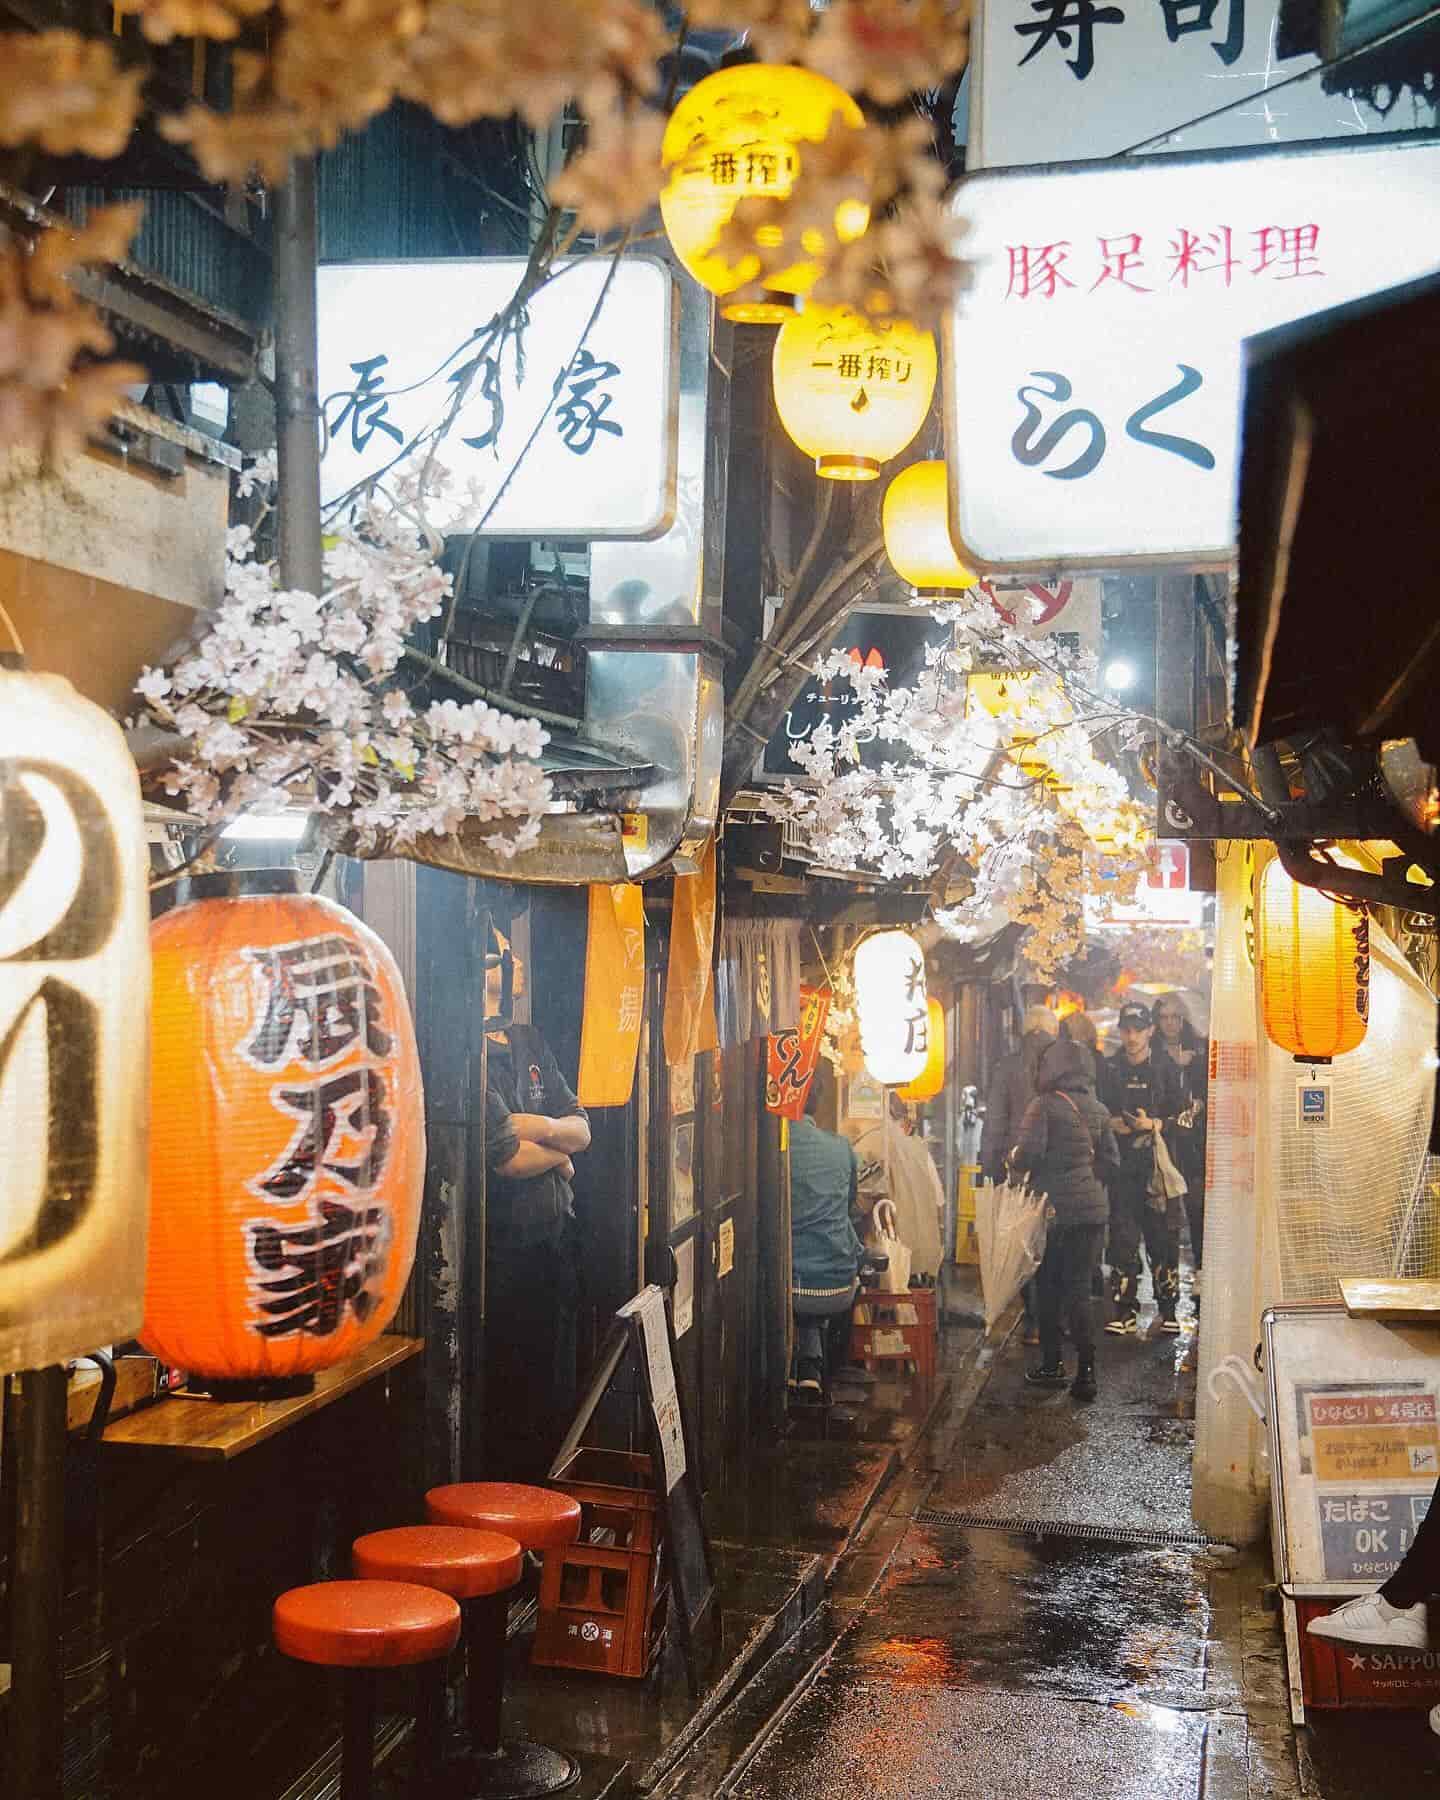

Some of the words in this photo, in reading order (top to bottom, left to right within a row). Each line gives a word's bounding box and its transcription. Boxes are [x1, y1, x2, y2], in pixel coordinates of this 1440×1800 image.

[1004, 223, 1325, 300] 豚足料理
[811, 353, 912, 382] 一番搾り
[330, 350, 624, 455] 辰乃家
[1011, 363, 1216, 481] らく
[1313, 1404, 1369, 1421] ひなどり
[1371, 1653, 1440, 1671] SAPPO
